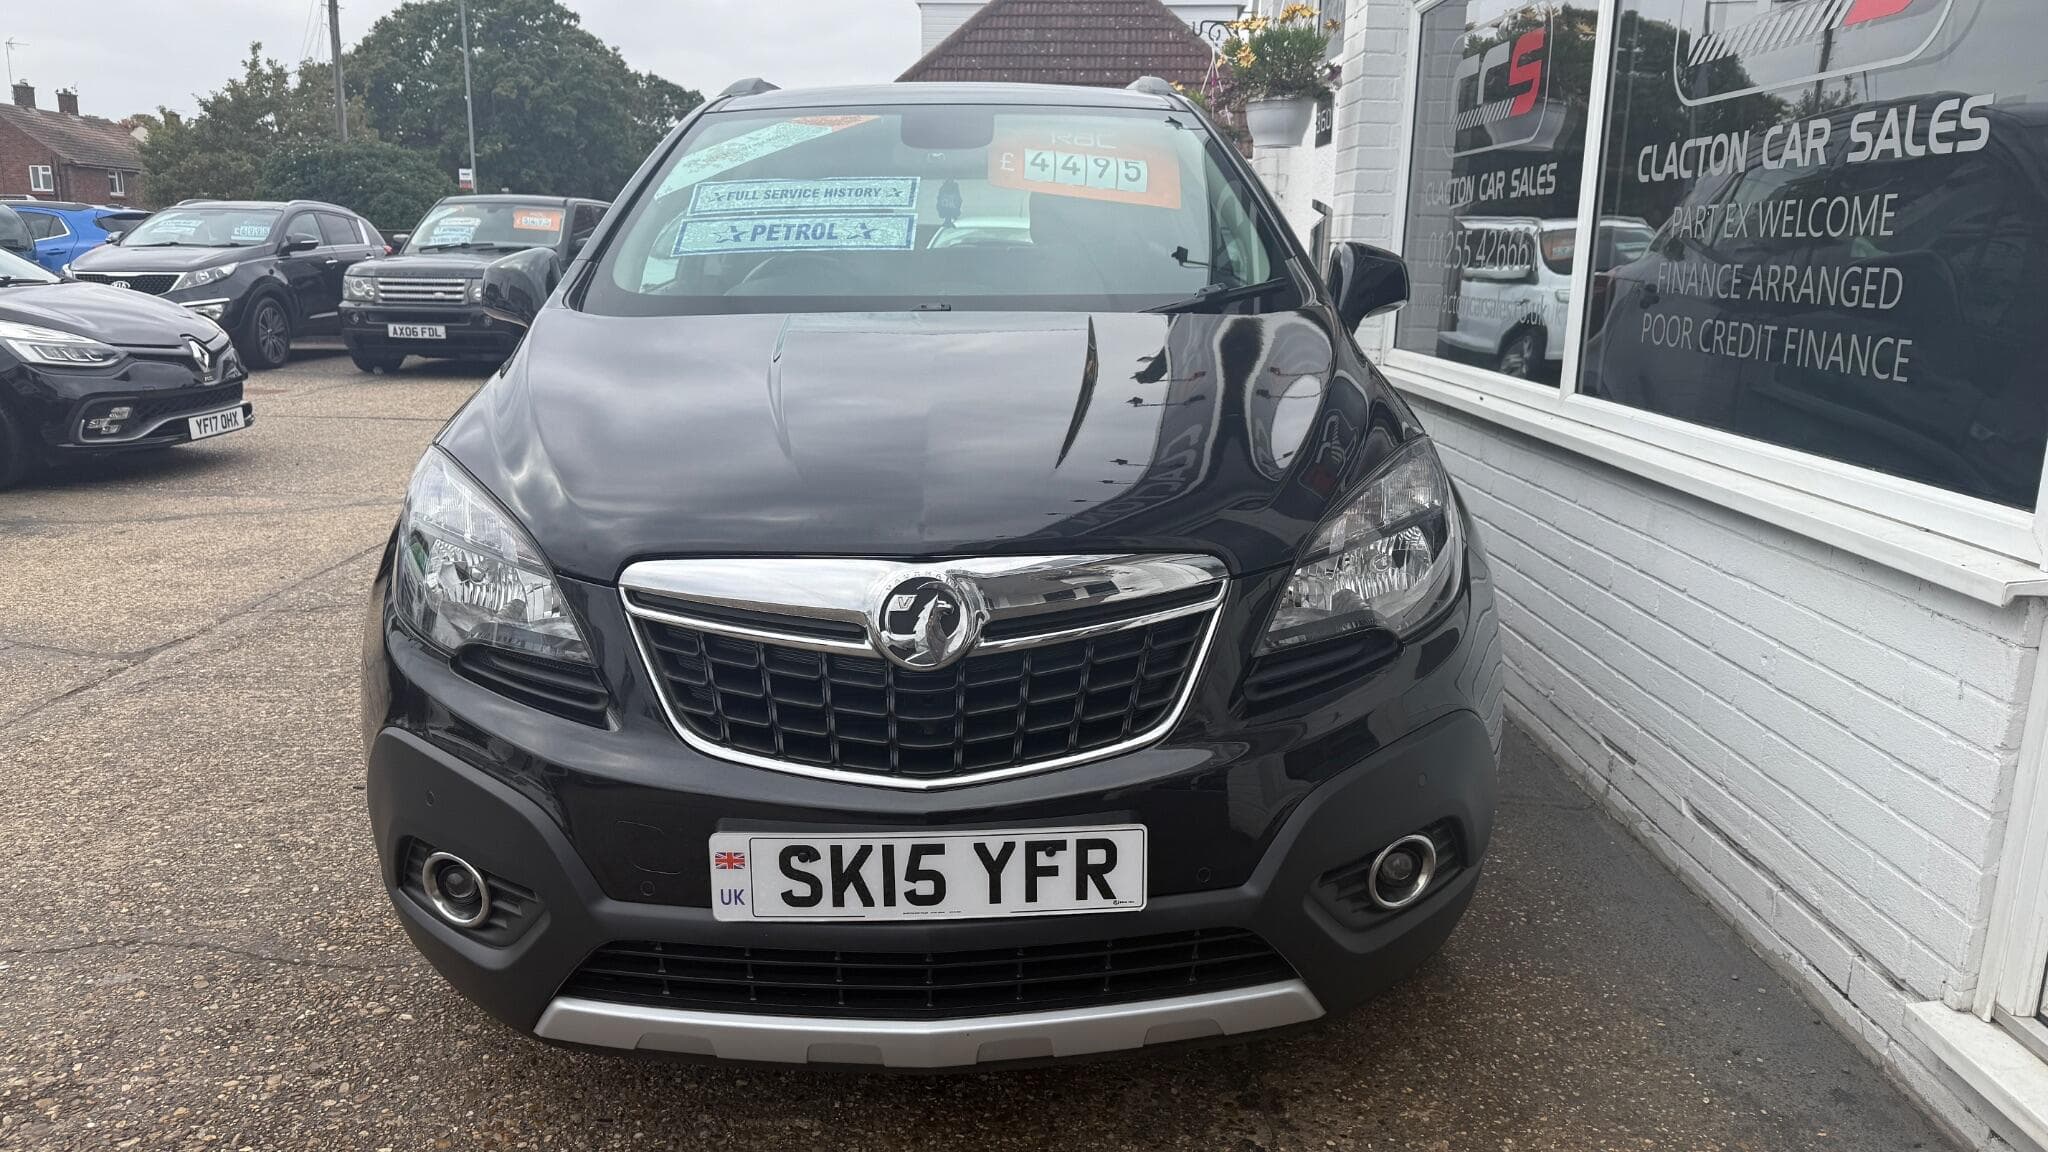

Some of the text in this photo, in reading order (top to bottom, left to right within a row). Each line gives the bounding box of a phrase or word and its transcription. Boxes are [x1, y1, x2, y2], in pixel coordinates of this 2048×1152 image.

[1638, 92, 1995, 183] CLACTON CAR SALES
[727, 187, 882, 201] FULL SERVICE HISTORY
[1425, 162, 1558, 206] CLACTON CAR SALES
[750, 222, 839, 242] PETROL
[1672, 193, 1898, 239] PART EX WELCOME
[1427, 230, 1473, 269] 01255
[1657, 262, 1904, 309] FINANCE ARRANGED
[392, 325, 442, 338] AX06 FDL
[1641, 312, 1912, 383] POOR CREDIT FINANCE
[196, 415, 218, 434] YF17
[778, 838, 1118, 908] SK15 YFR
[720, 888, 746, 906] UK
